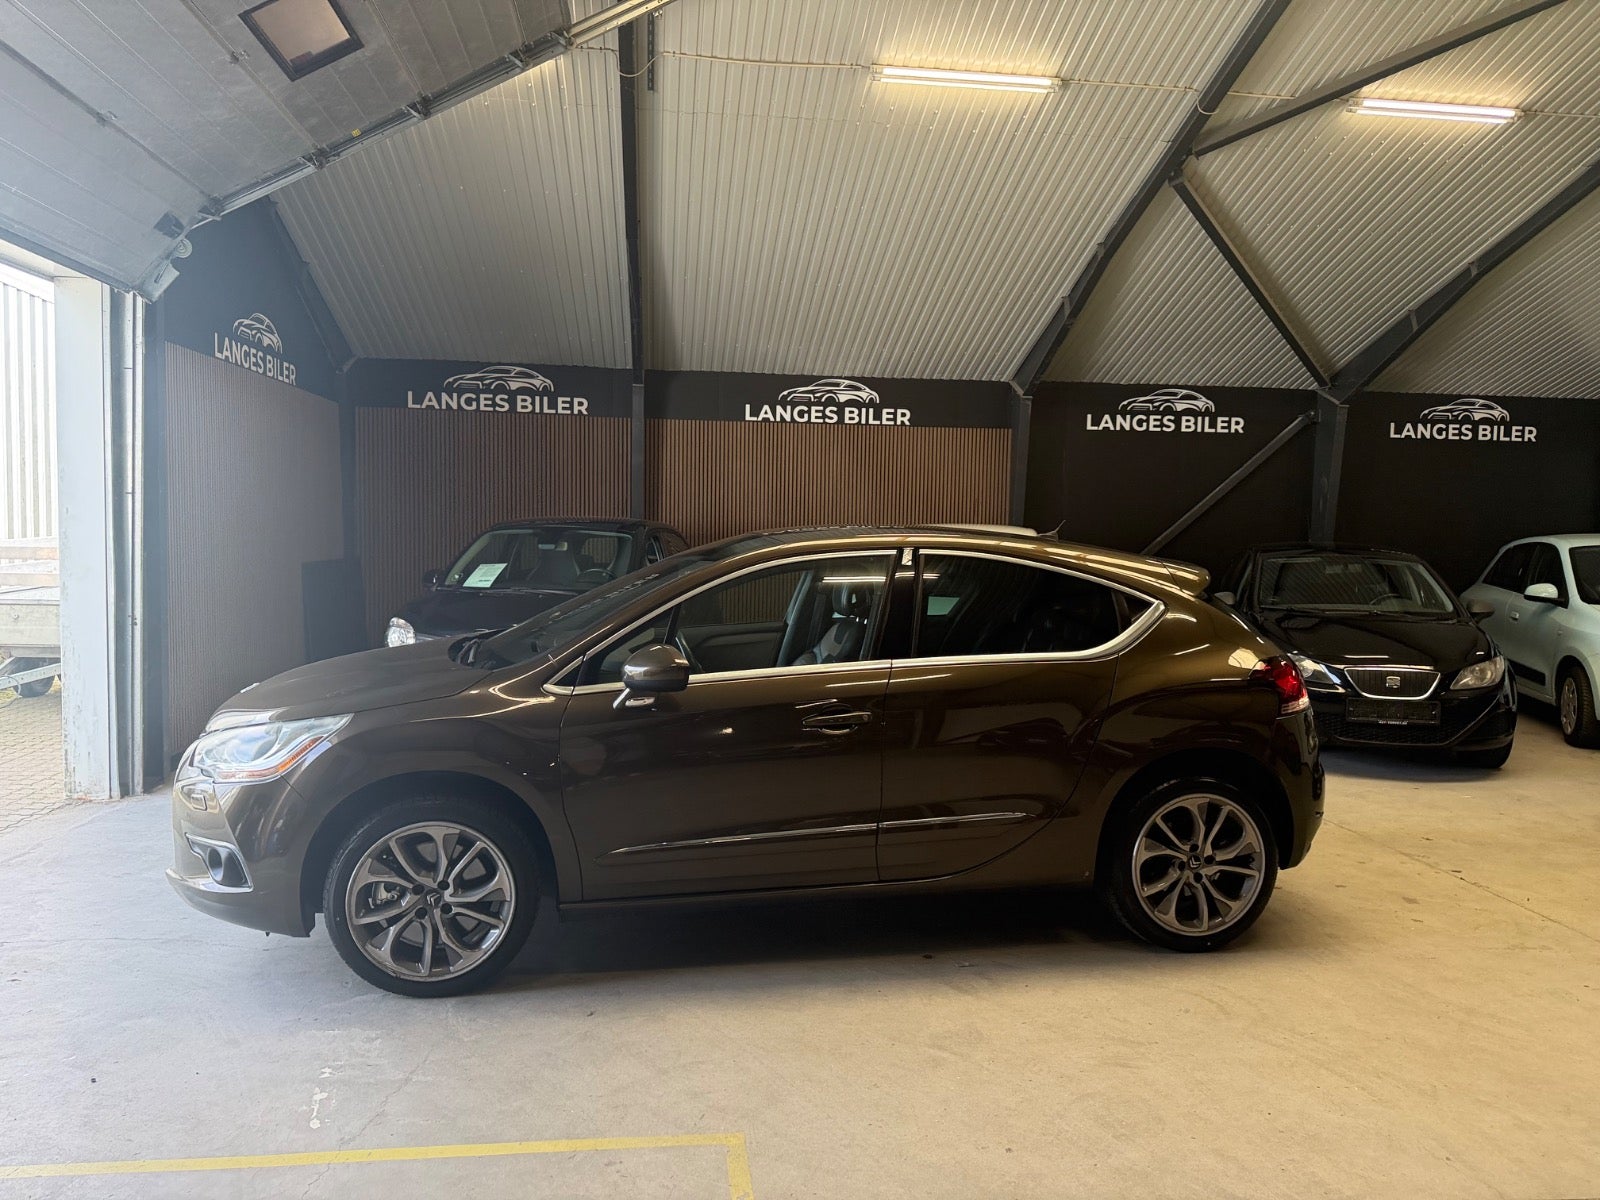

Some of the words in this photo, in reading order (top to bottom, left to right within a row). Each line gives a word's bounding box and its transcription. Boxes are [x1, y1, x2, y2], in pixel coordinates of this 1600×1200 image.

[214, 332, 264, 374] LANGES
[266, 354, 296, 386] BILER
[407, 391, 510, 412] LANGES
[516, 396, 589, 415] BILER
[745, 404, 838, 423] LANGES
[844, 407, 911, 425] BILER
[1086, 414, 1175, 431] LANGES
[1181, 416, 1244, 433] BILER
[1390, 423, 1472, 440] LANGES
[1478, 424, 1537, 442] BILER
